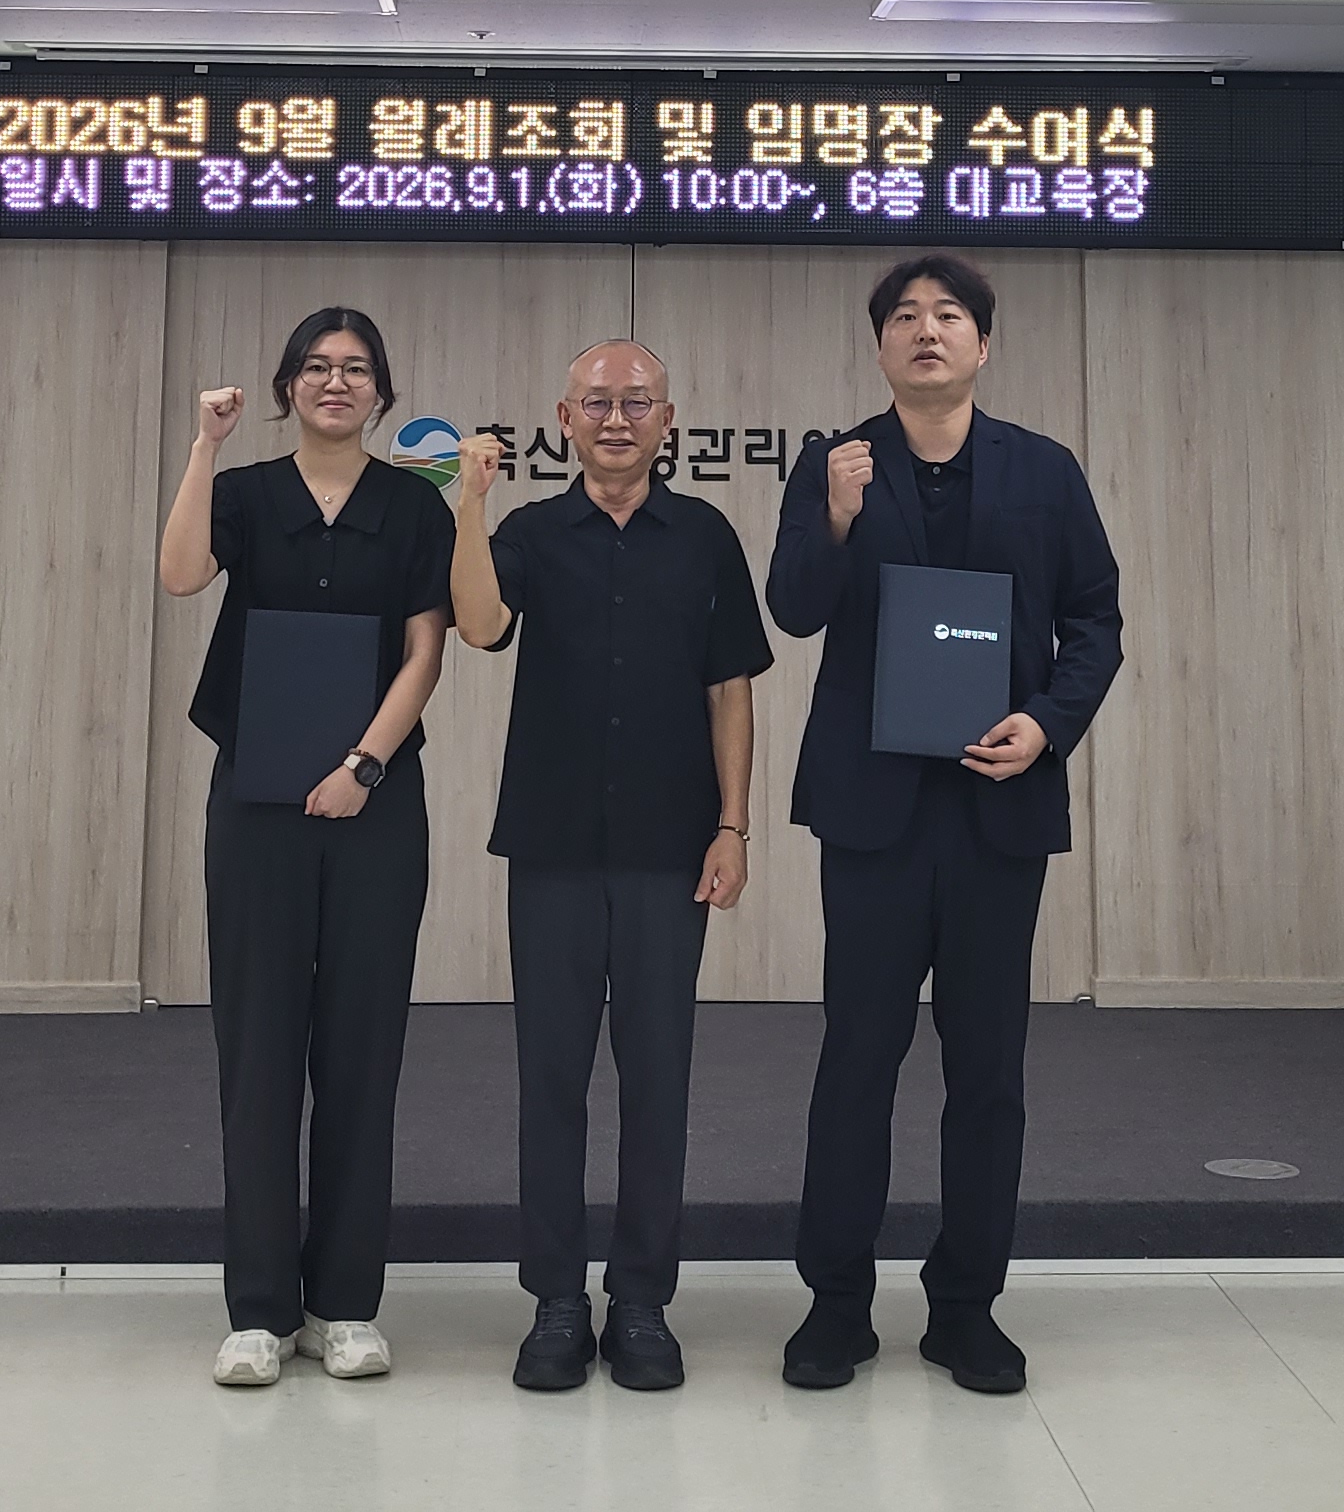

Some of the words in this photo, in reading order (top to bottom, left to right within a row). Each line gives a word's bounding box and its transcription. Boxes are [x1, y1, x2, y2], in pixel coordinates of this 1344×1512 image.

[236, 96, 337, 161] 9월
[656, 100, 715, 164] 및
[745, 101, 943, 166] 임명장
[967, 104, 1156, 169] 수여식
[122, 157, 172, 213] 및
[198, 157, 316, 213] 장소:
[336, 159, 644, 215] 2026.9.1.(화)
[849, 165, 925, 218] 6층
[946, 165, 1150, 221] 대교육장
